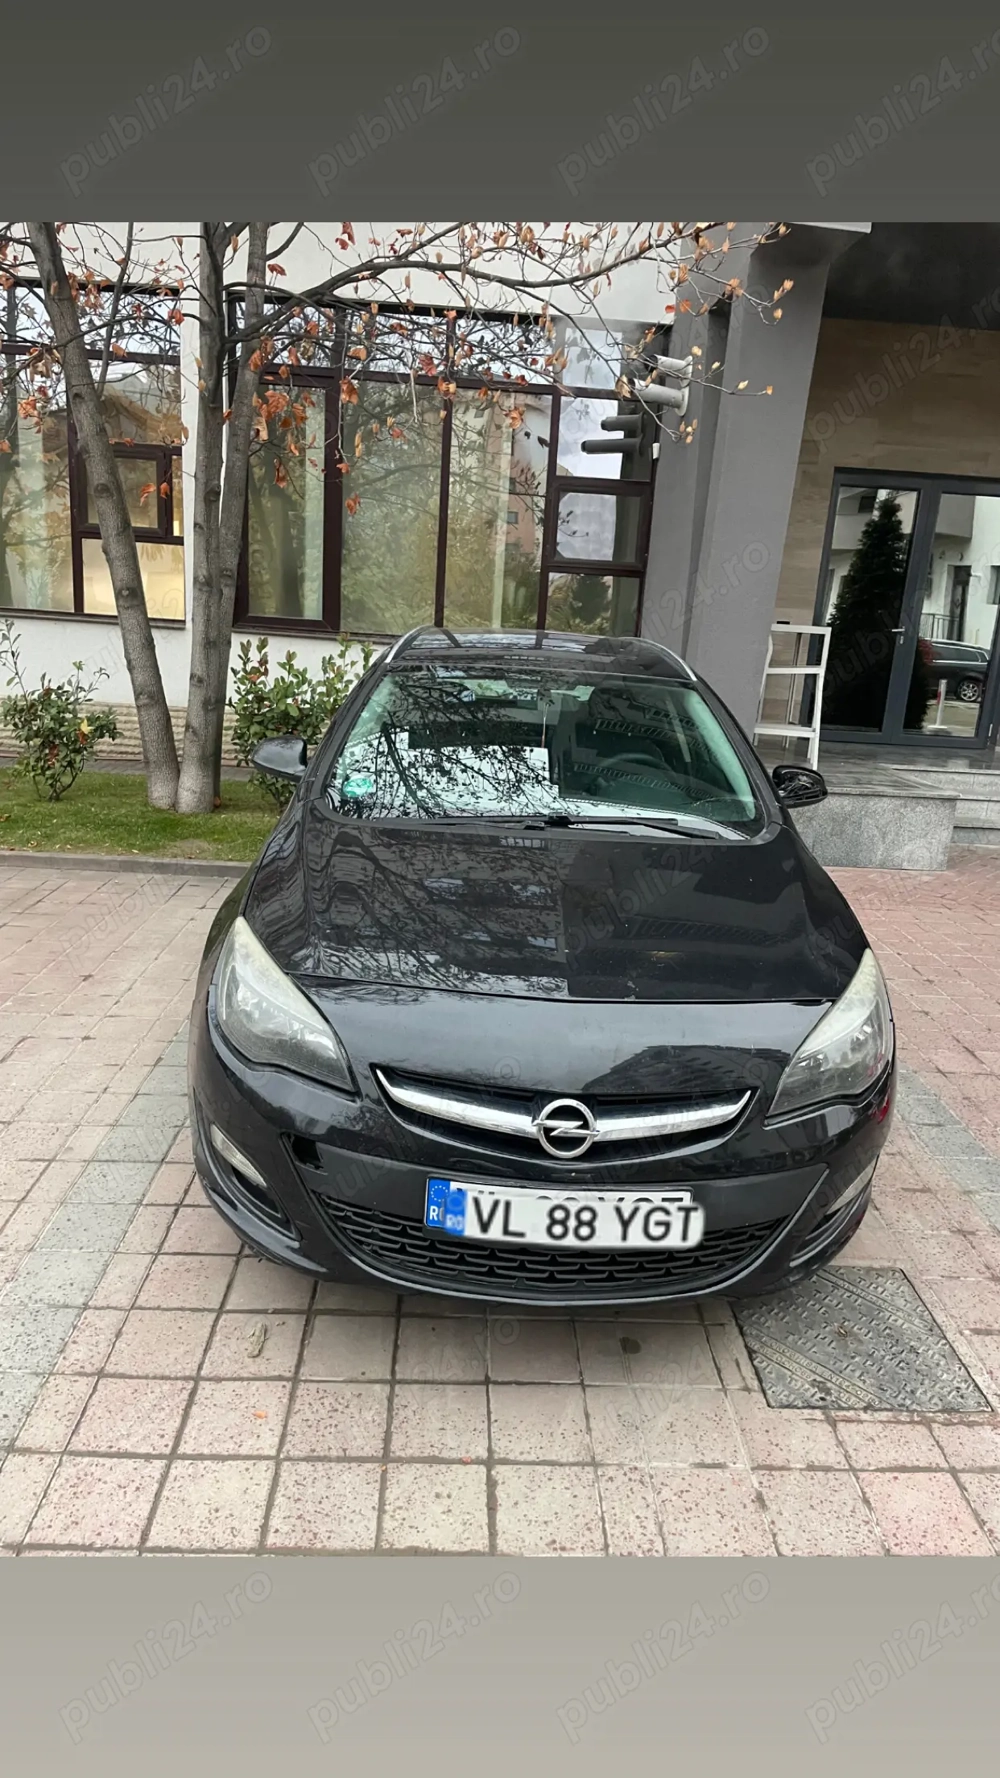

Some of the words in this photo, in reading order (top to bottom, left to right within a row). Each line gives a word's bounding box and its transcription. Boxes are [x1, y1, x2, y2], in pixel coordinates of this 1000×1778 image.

[472, 1195, 526, 1239] VL
[546, 1203, 598, 1241] 88
[614, 1204, 700, 1242] YGT
